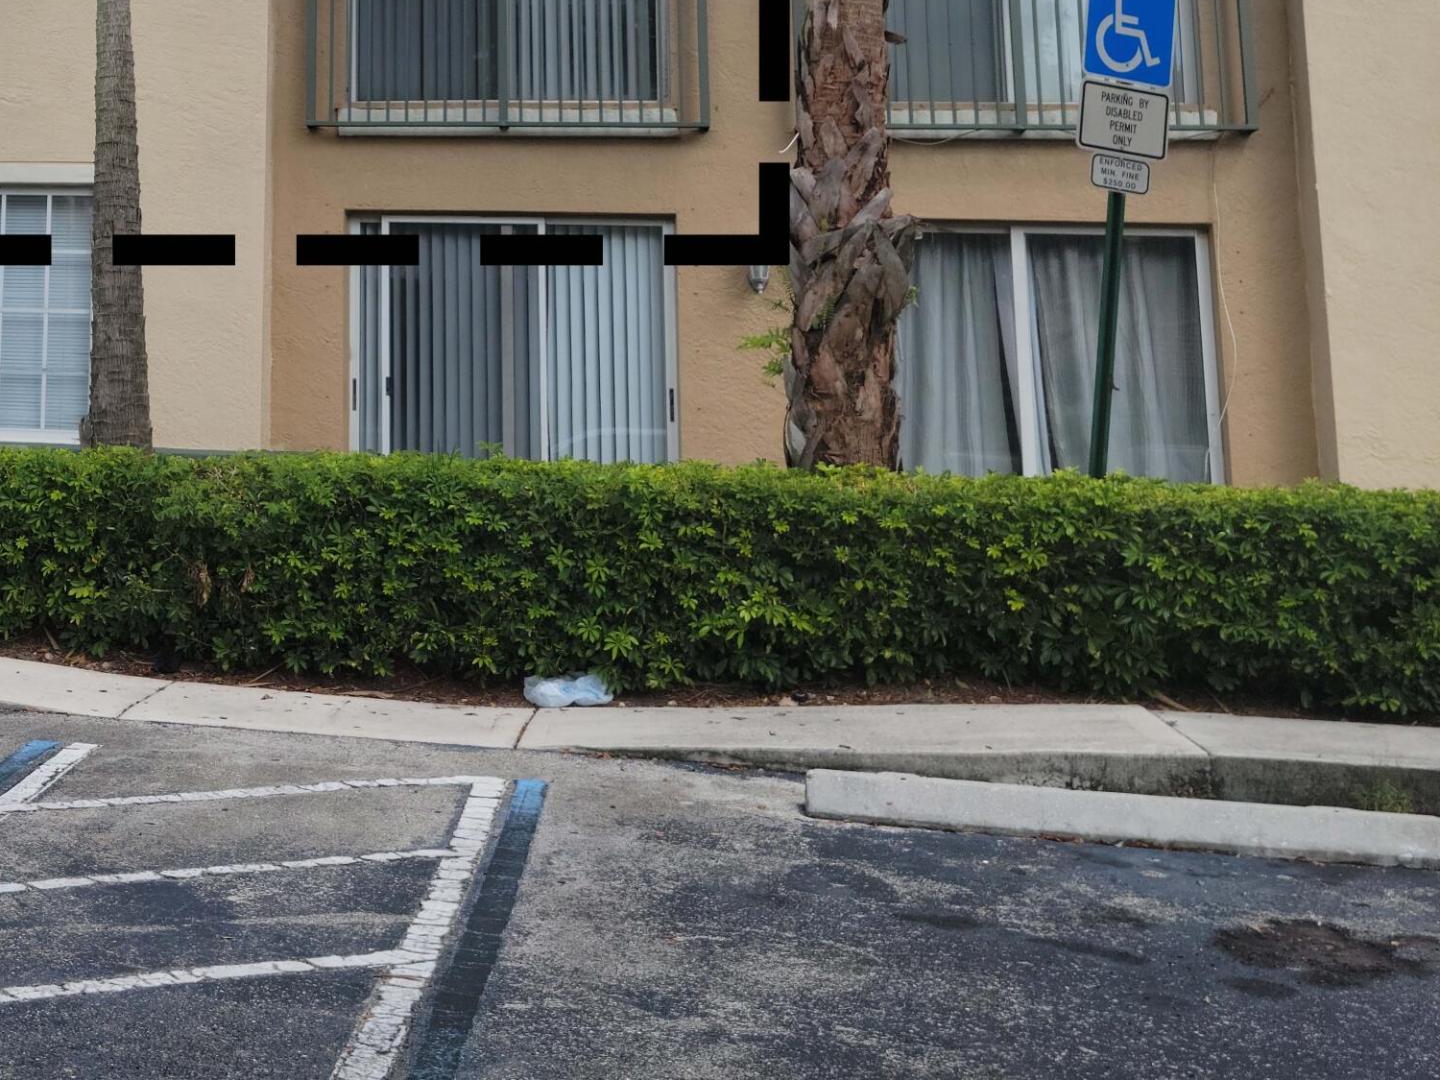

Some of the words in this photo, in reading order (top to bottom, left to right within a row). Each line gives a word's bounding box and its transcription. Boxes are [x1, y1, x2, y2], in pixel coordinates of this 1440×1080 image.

[1100, 90, 1134, 107] PARKING
[1138, 97, 1150, 110] BY
[1105, 105, 1144, 122] DISABLED
[1109, 119, 1137, 135] PERMIT
[1112, 134, 1133, 148] ONLY
[1098, 157, 1143, 172] ENFORCED
[1122, 170, 1140, 180] FINE
[1102, 178, 1137, 190] $250.00
